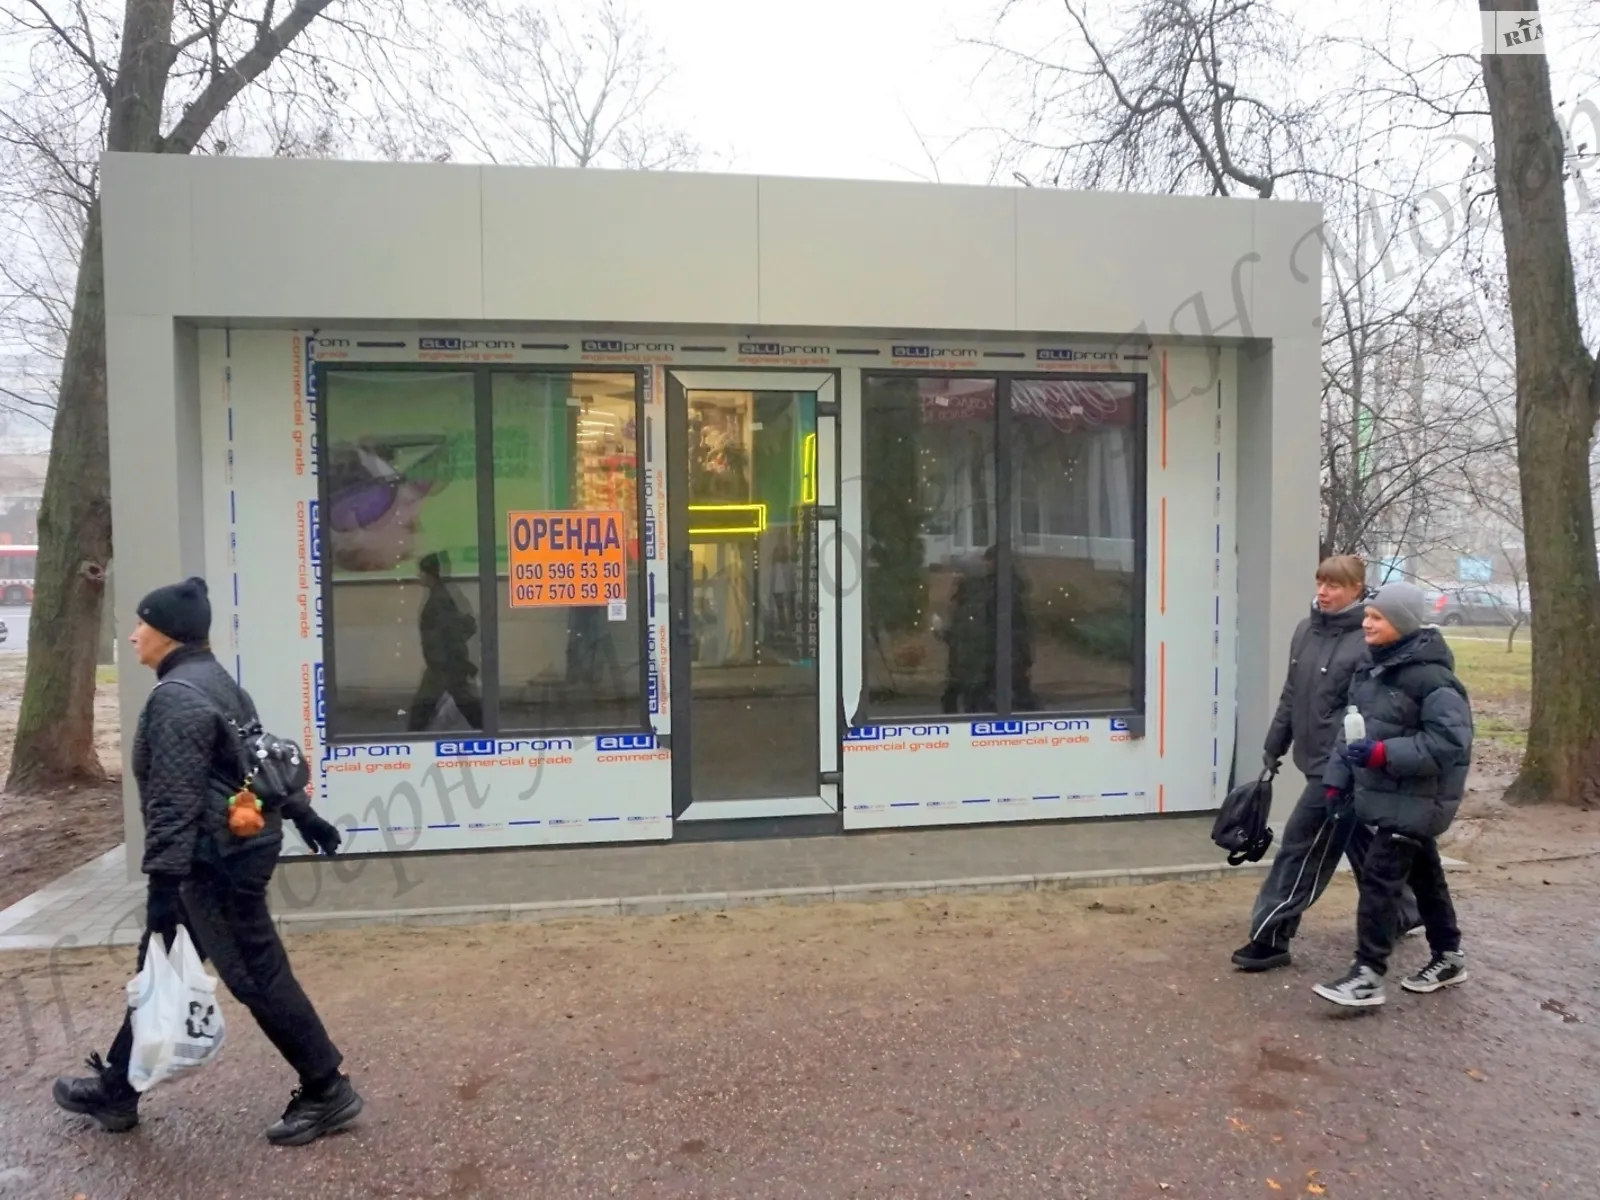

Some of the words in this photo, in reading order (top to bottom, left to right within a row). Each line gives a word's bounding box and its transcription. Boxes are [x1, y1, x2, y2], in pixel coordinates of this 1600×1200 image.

[292, 430, 305, 475] grade
[297, 501, 309, 589] commercial
[513, 518, 620, 556] ОРЕНДА
[516, 564, 542, 579] 050
[548, 563, 575, 579] 596
[580, 563, 598, 578] 53
[603, 563, 620, 578] 50
[517, 585, 543, 600] 067
[549, 584, 576, 599] 570
[581, 583, 598, 598] 59
[604, 583, 621, 598] 30
[297, 593, 310, 639] grade
[302, 664, 314, 750] commercial
[909, 740, 949, 752] grade
[971, 736, 1049, 748] commercial
[1052, 734, 1090, 747] grade
[365, 760, 411, 774] grade
[436, 757, 520, 769] commercial
[525, 755, 572, 768] grade
